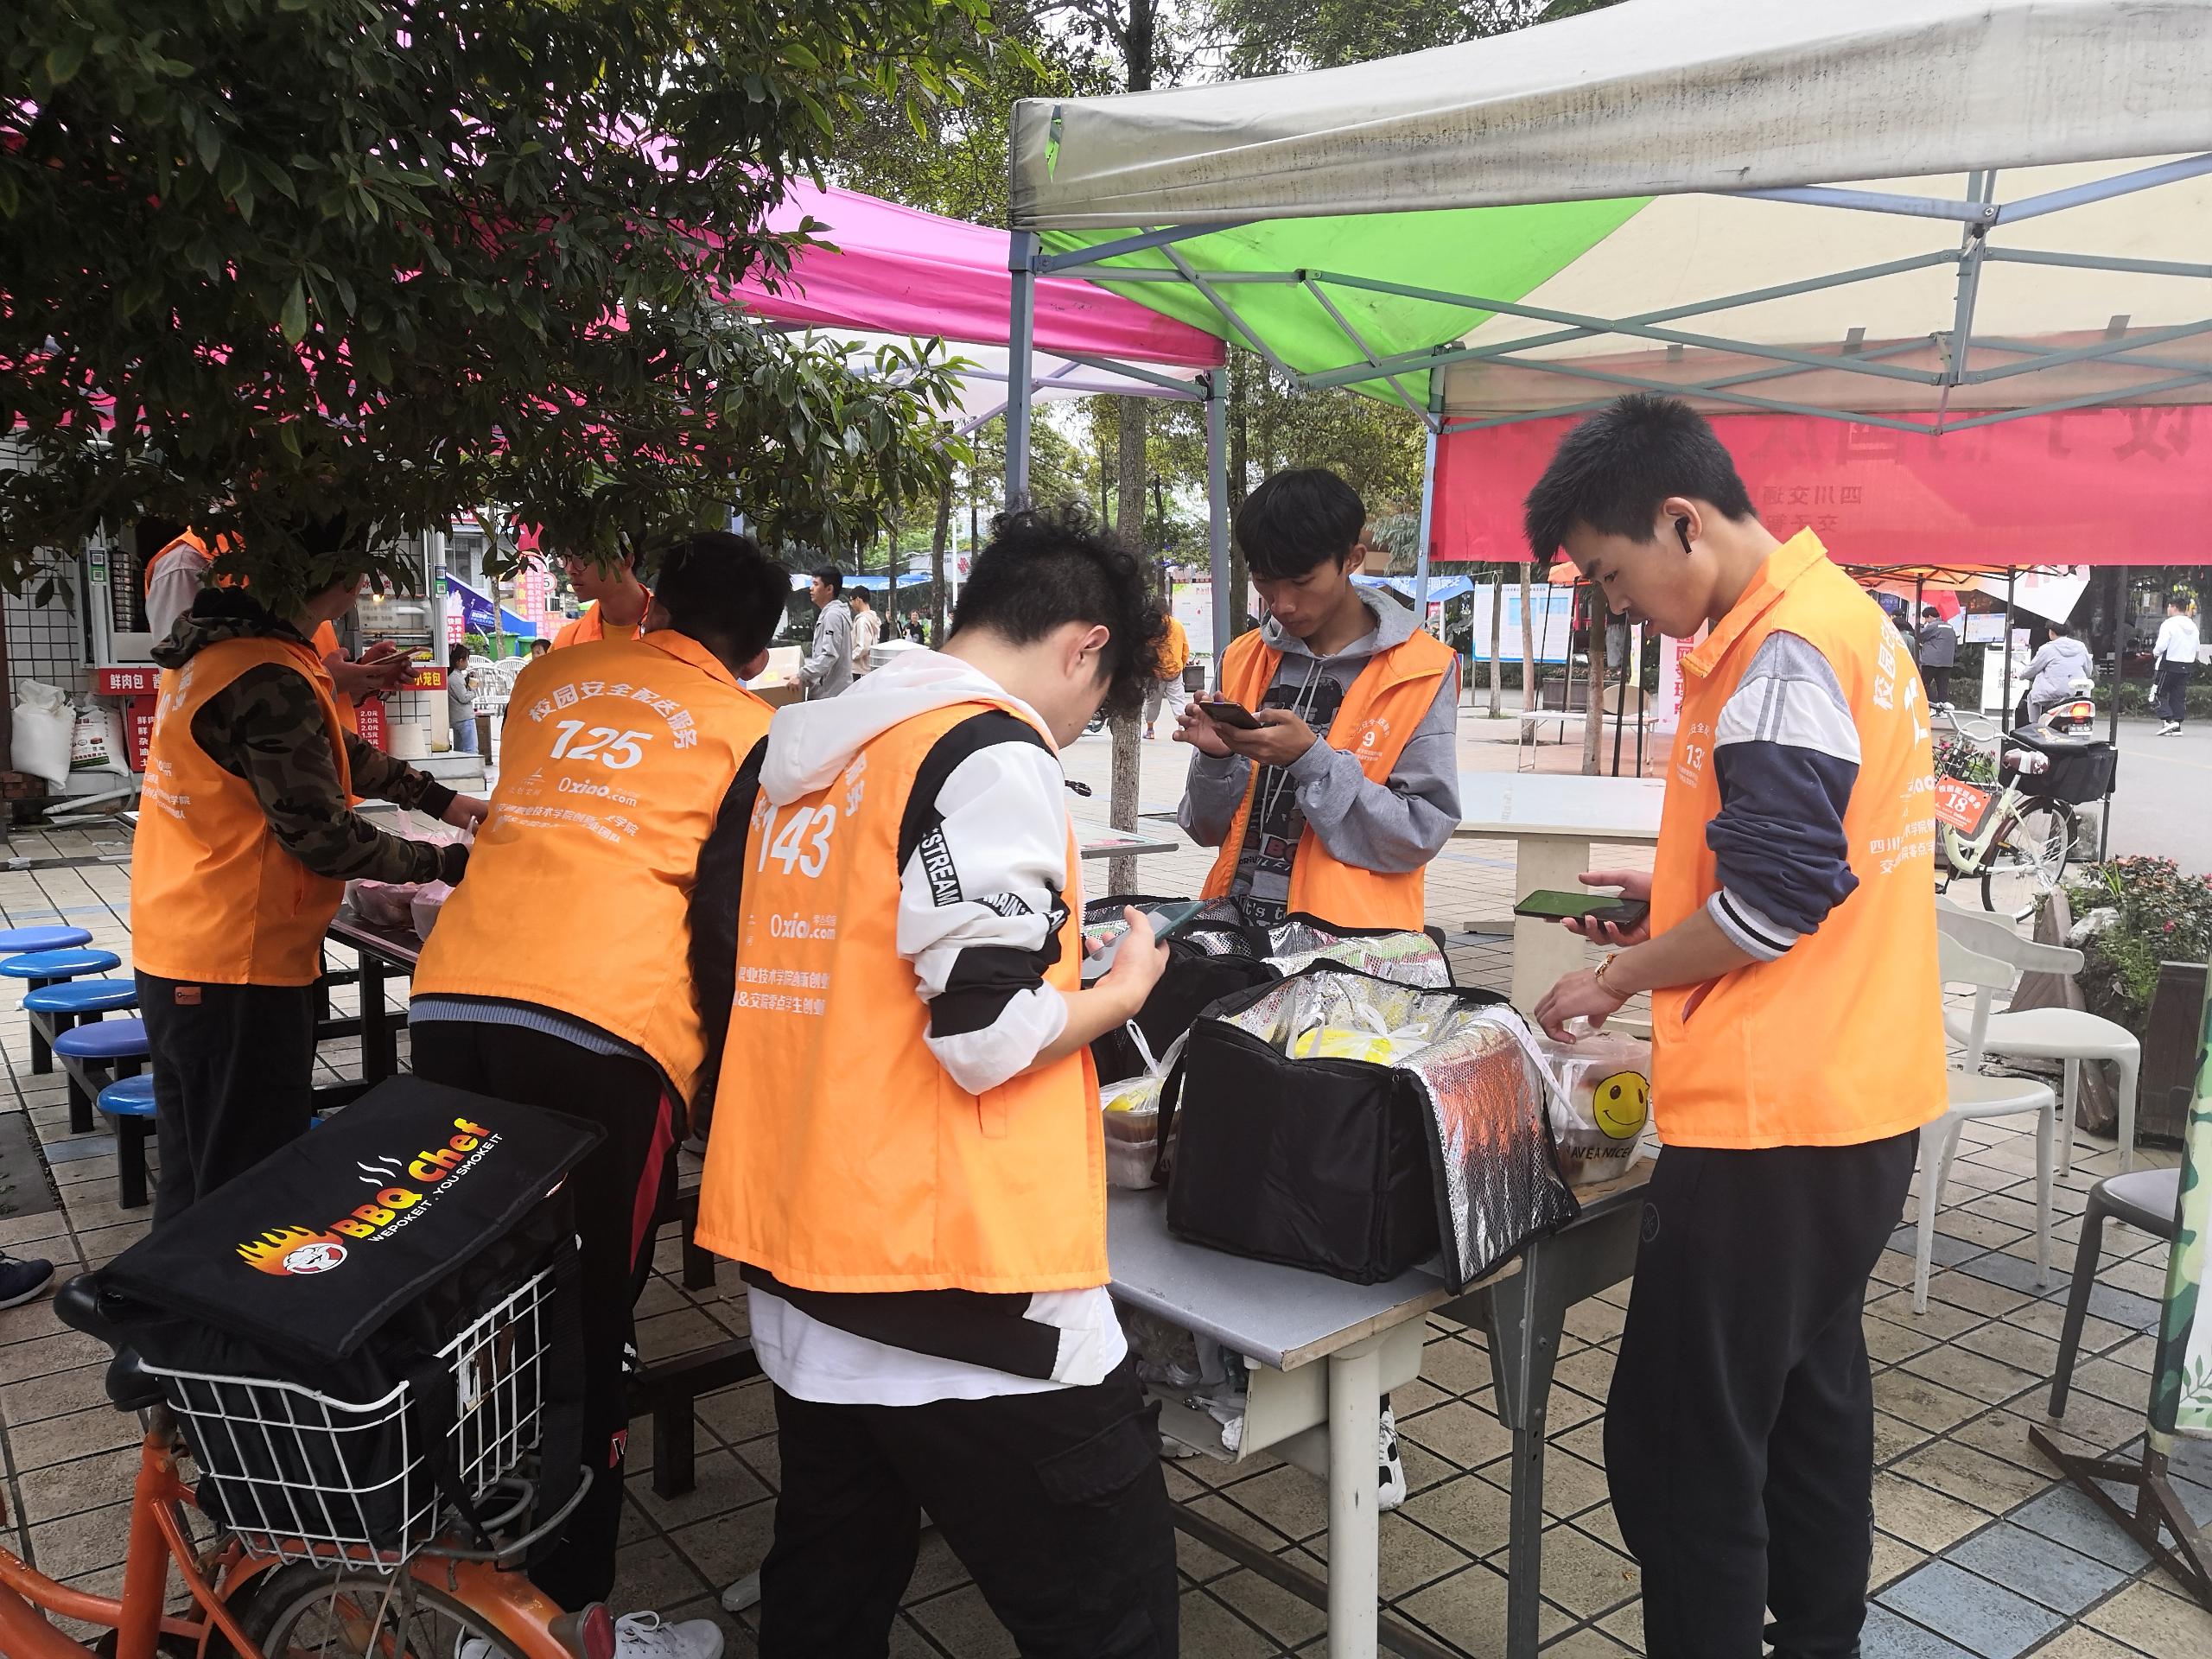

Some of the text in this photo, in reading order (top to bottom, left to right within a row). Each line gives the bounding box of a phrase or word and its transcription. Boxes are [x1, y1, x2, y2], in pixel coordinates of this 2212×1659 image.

[110, 674, 144, 690] 鲜肉包
[415, 672, 442, 686] 小笼包
[528, 681, 697, 749] 校园安全配送服务
[550, 720, 654, 769] 125
[1362, 731, 1376, 747] 9
[1945, 793, 1968, 813] 18
[757, 804, 837, 878] 143
[921, 832, 964, 907] STREAM
[1567, 1146, 1593, 1160] AVE
[330, 1117, 491, 1239] BBQ Chef
